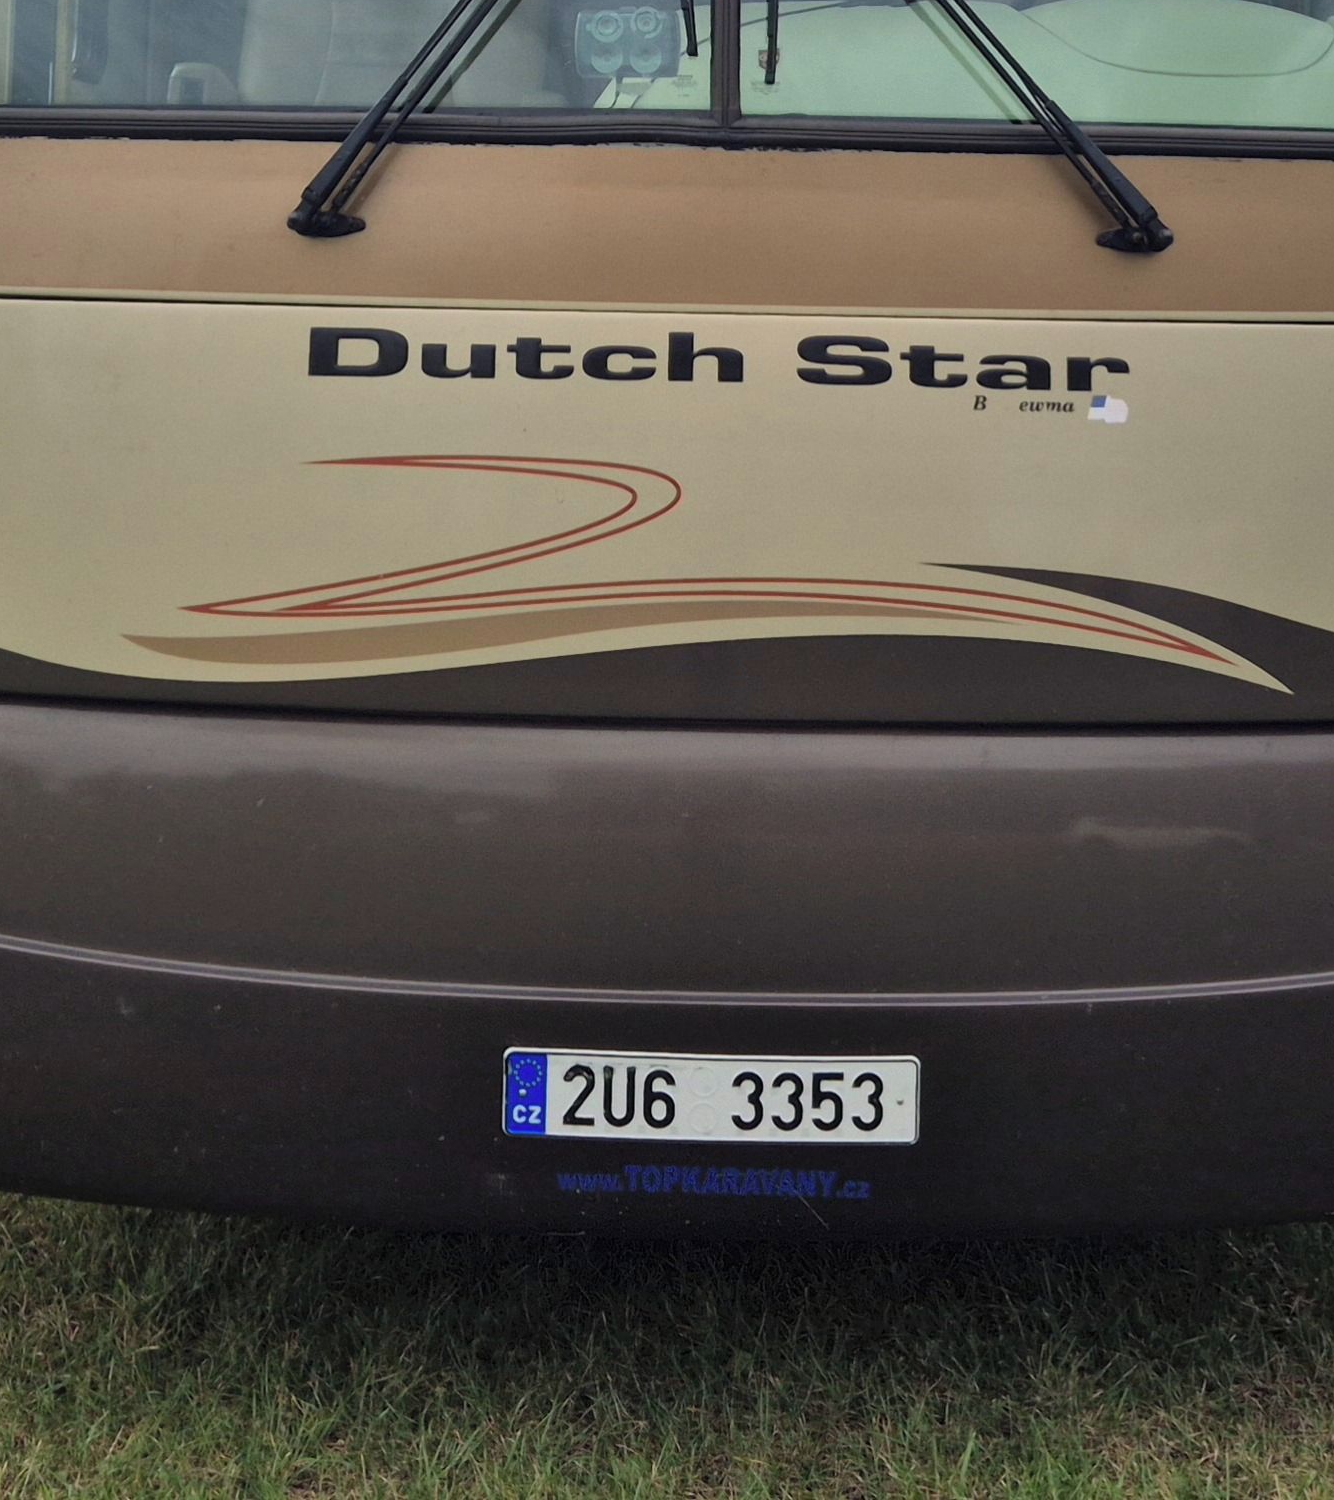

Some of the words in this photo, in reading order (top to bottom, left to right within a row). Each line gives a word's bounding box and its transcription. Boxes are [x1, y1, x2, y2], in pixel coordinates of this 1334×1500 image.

[307, 326, 745, 384] Dutch
[796, 334, 1131, 392] Star
[512, 1104, 542, 1125] CZ
[561, 1063, 678, 1129] 2U6
[730, 1071, 885, 1133] 3353
[556, 1164, 873, 1199] www.TOPKARAVANY.cz
